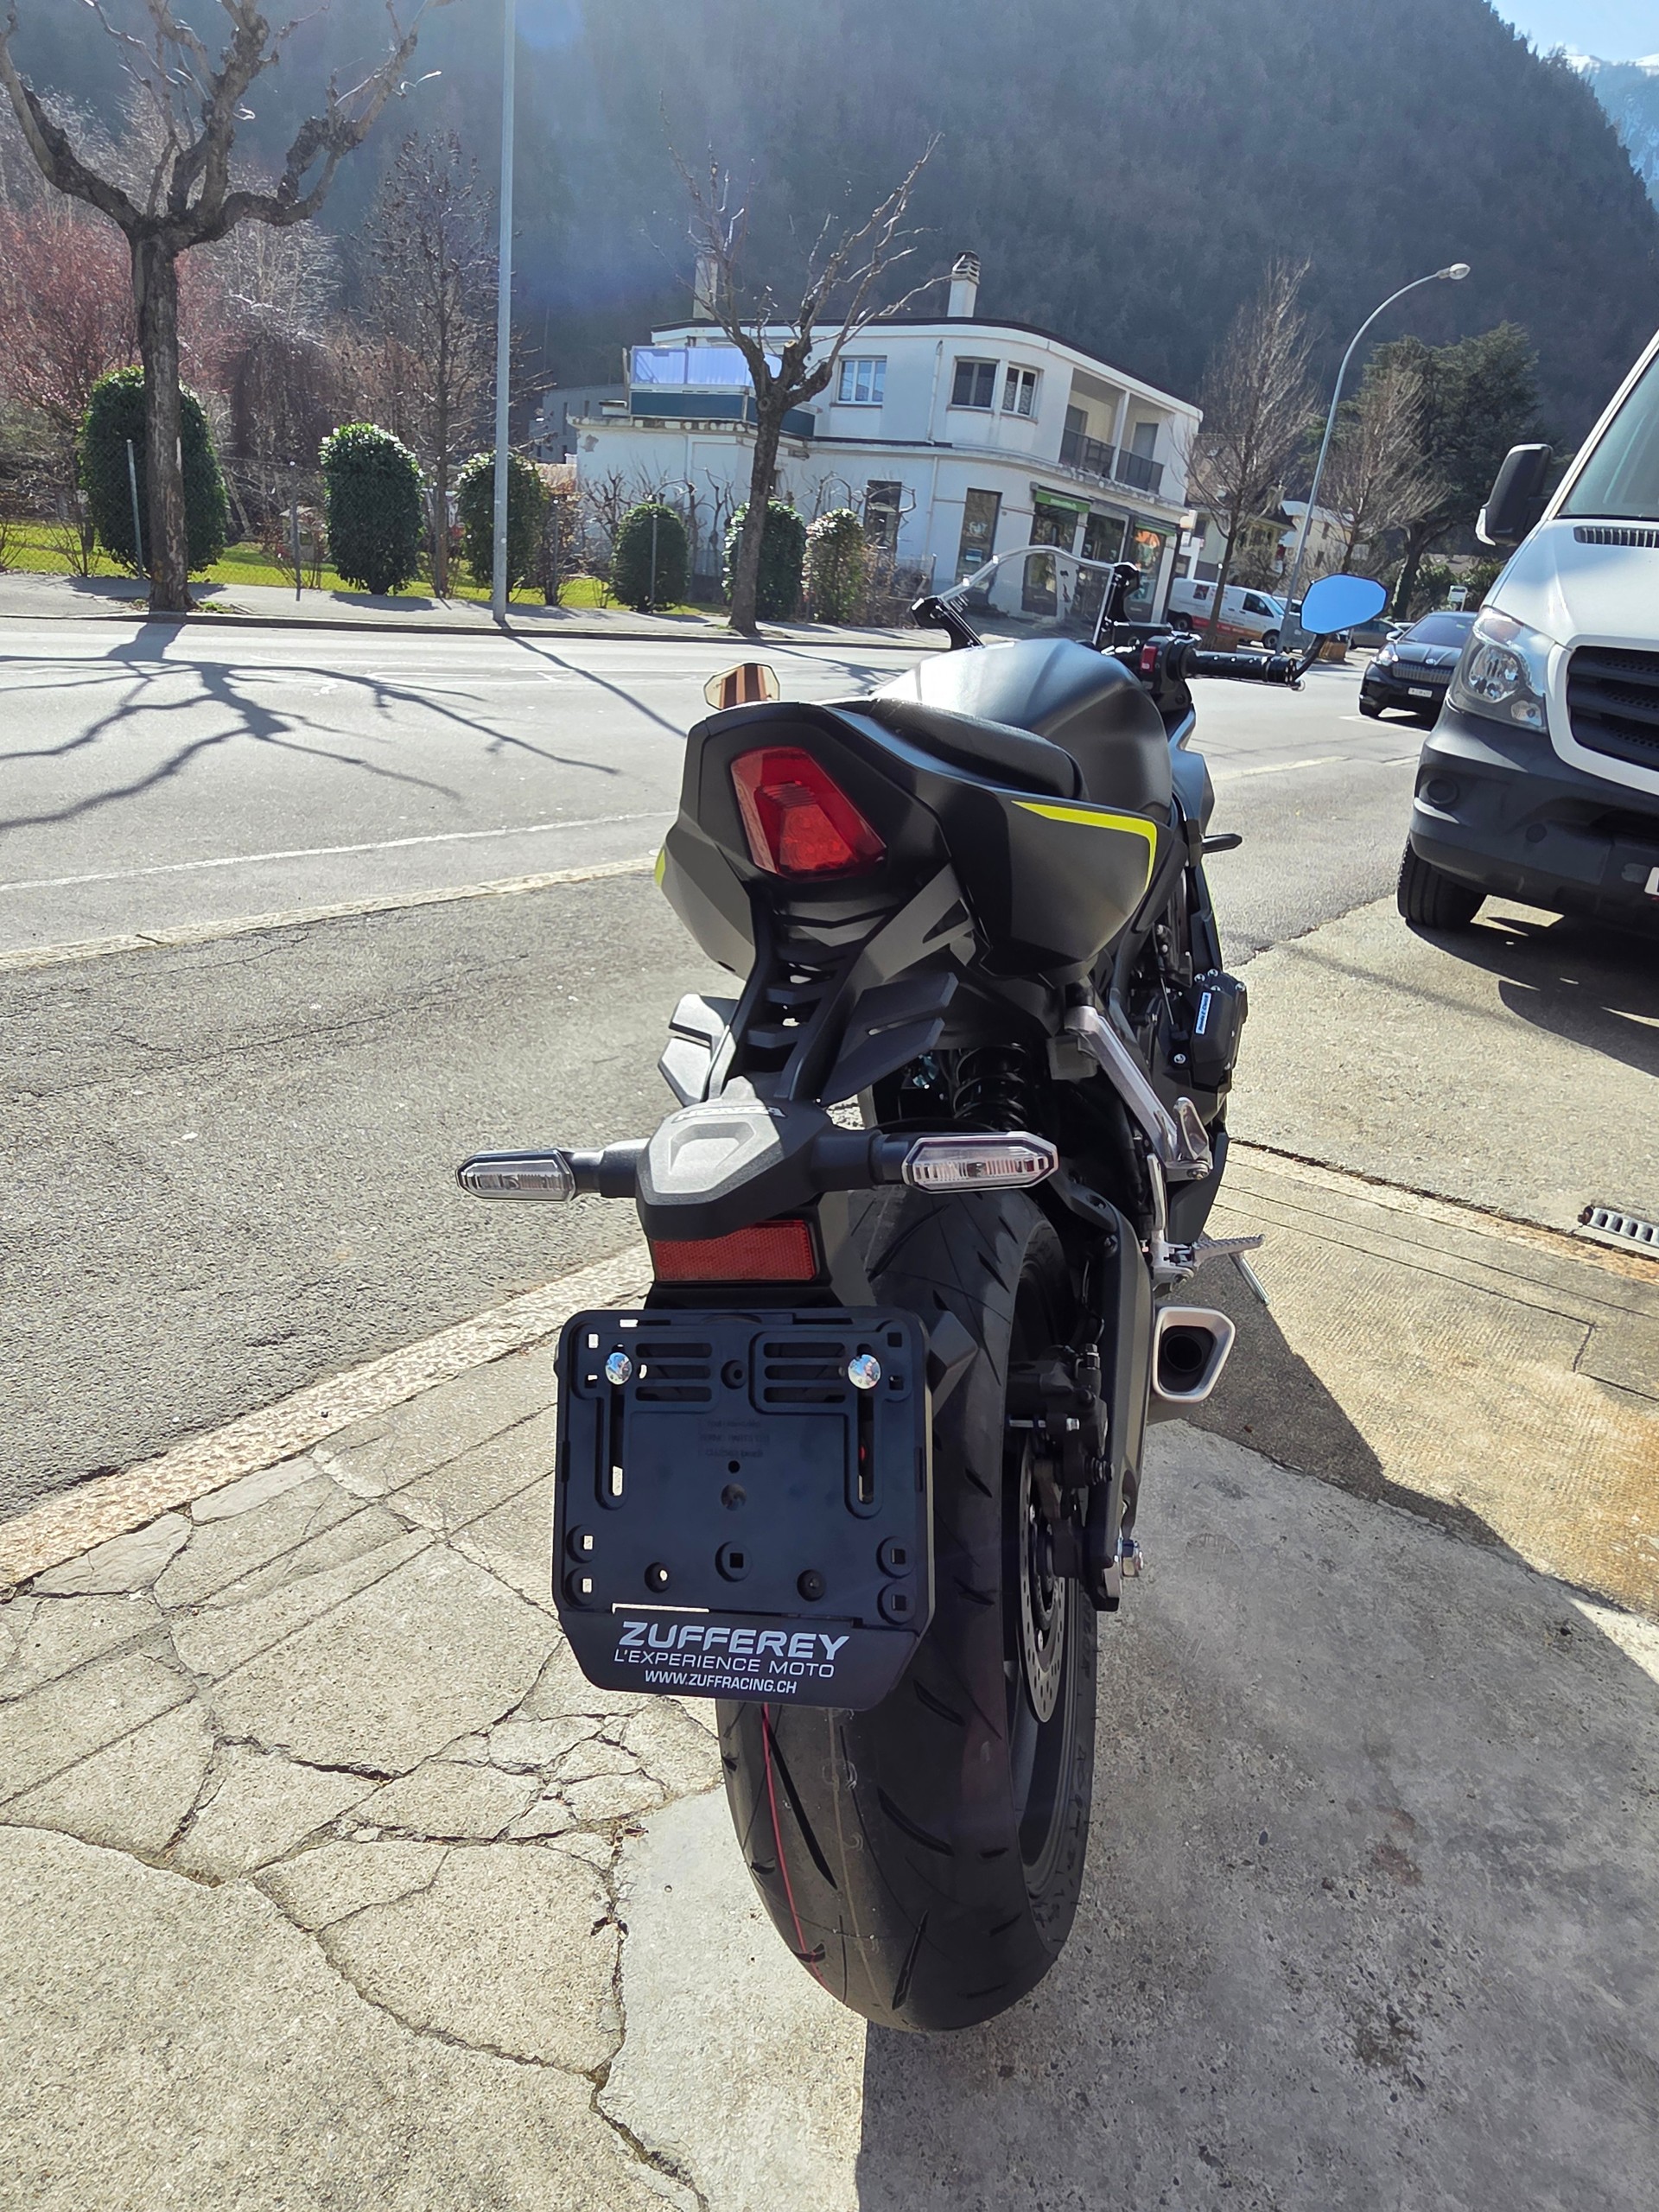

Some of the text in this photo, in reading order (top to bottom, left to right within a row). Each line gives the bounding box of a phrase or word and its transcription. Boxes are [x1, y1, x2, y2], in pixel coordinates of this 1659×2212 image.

[619, 1621, 850, 1661] ZUFFEREY
[613, 1649, 835, 1678] L'EXPERIENCE MOTO
[645, 1669, 798, 1694] WWW.ZUFFRACING.CH
